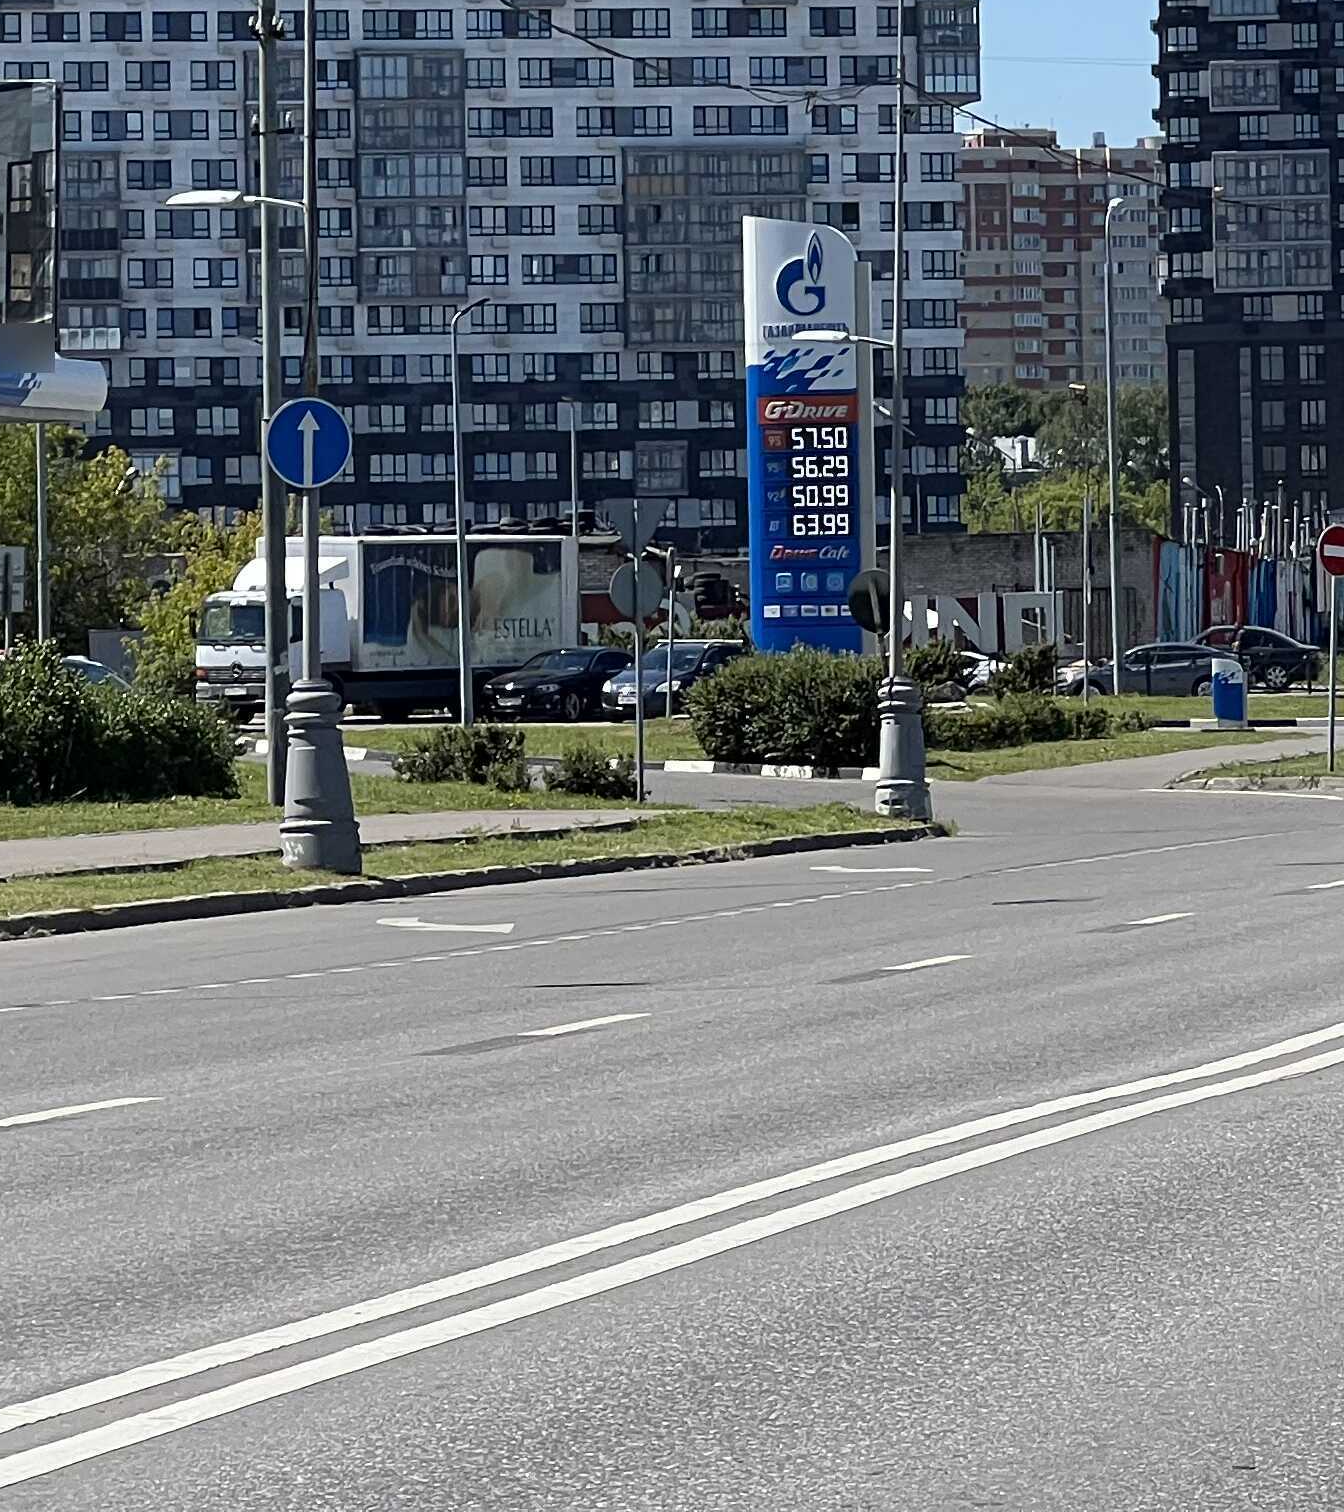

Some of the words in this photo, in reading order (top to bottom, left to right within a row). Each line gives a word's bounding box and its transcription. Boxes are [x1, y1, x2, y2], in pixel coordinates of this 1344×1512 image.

[791, 427, 848, 450] 57.50
[792, 455, 849, 478] 56.29
[792, 484, 849, 507] 50.99
[793, 513, 850, 536] 63.99
[494, 617, 552, 639] ESTELLA
